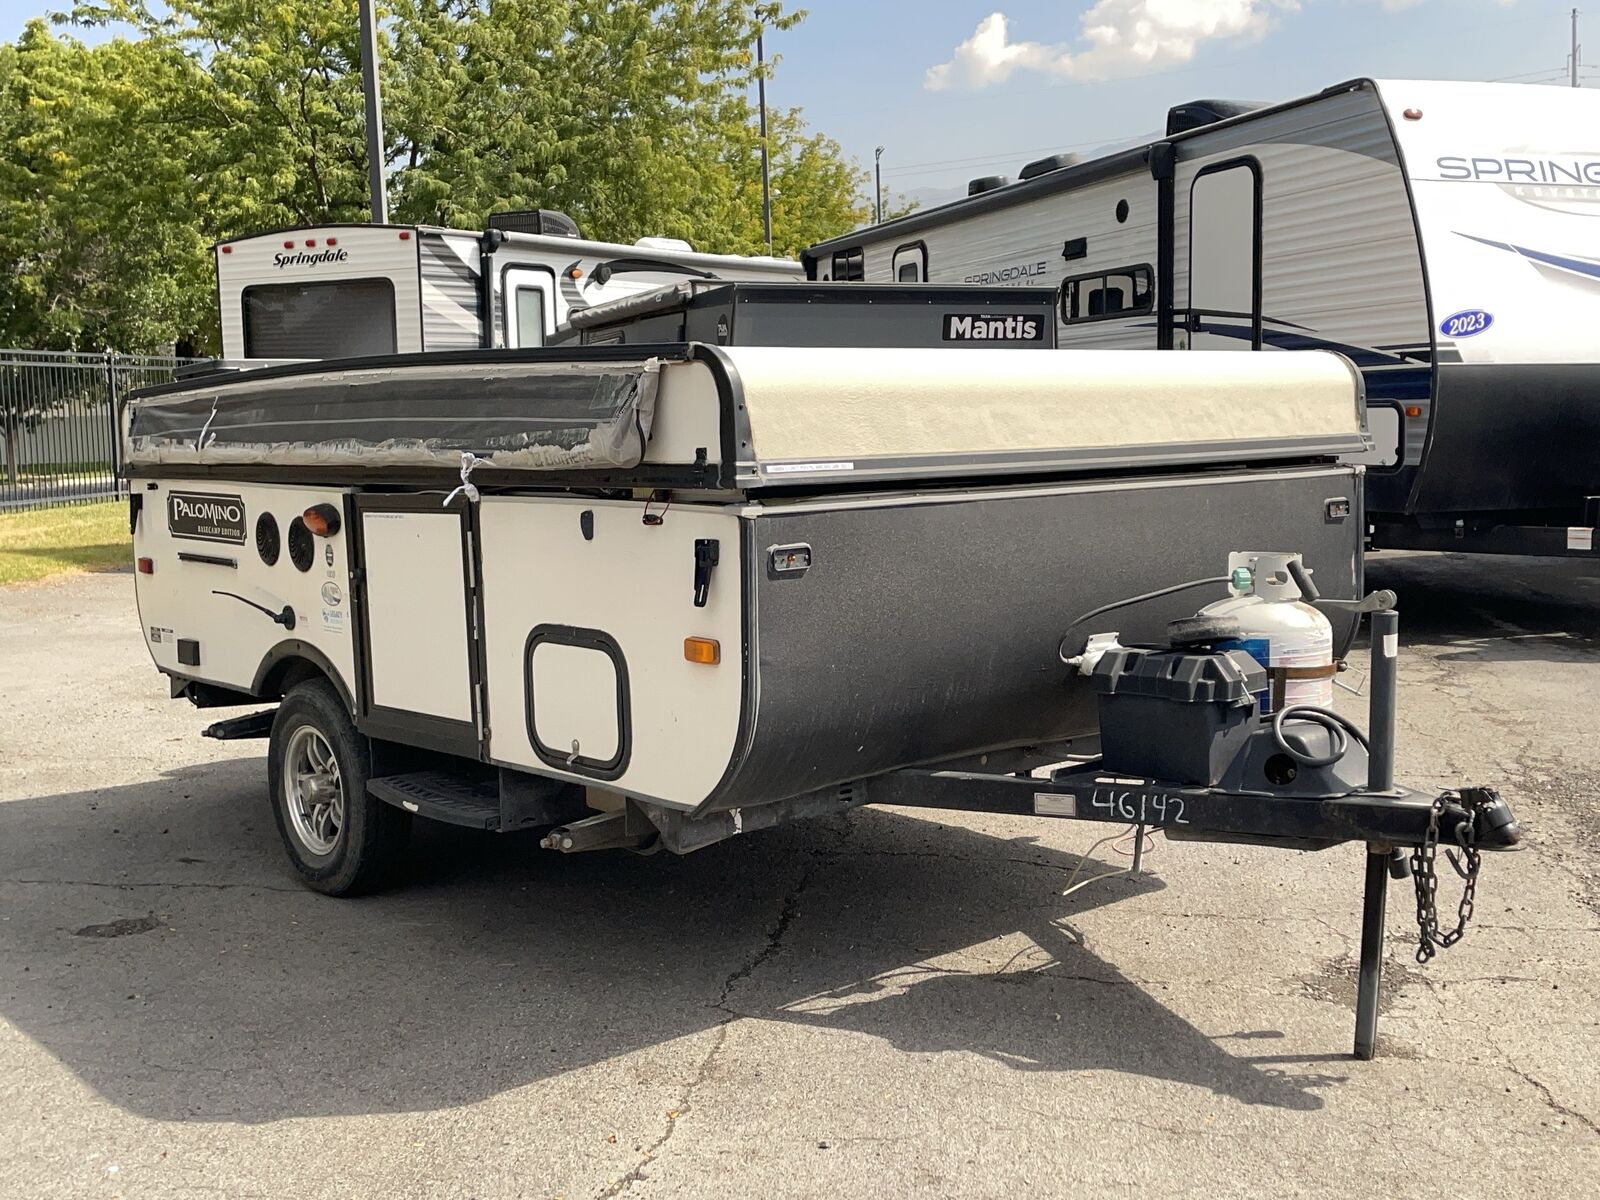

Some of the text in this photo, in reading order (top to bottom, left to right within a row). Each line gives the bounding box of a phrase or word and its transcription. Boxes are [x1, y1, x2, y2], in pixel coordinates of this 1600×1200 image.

[273, 248, 348, 268] Springdale
[950, 316, 1037, 339] Mantis
[1450, 312, 1485, 335] 2023
[221, 527, 240, 537] EDITION
[1092, 789, 1190, 824] 46142
